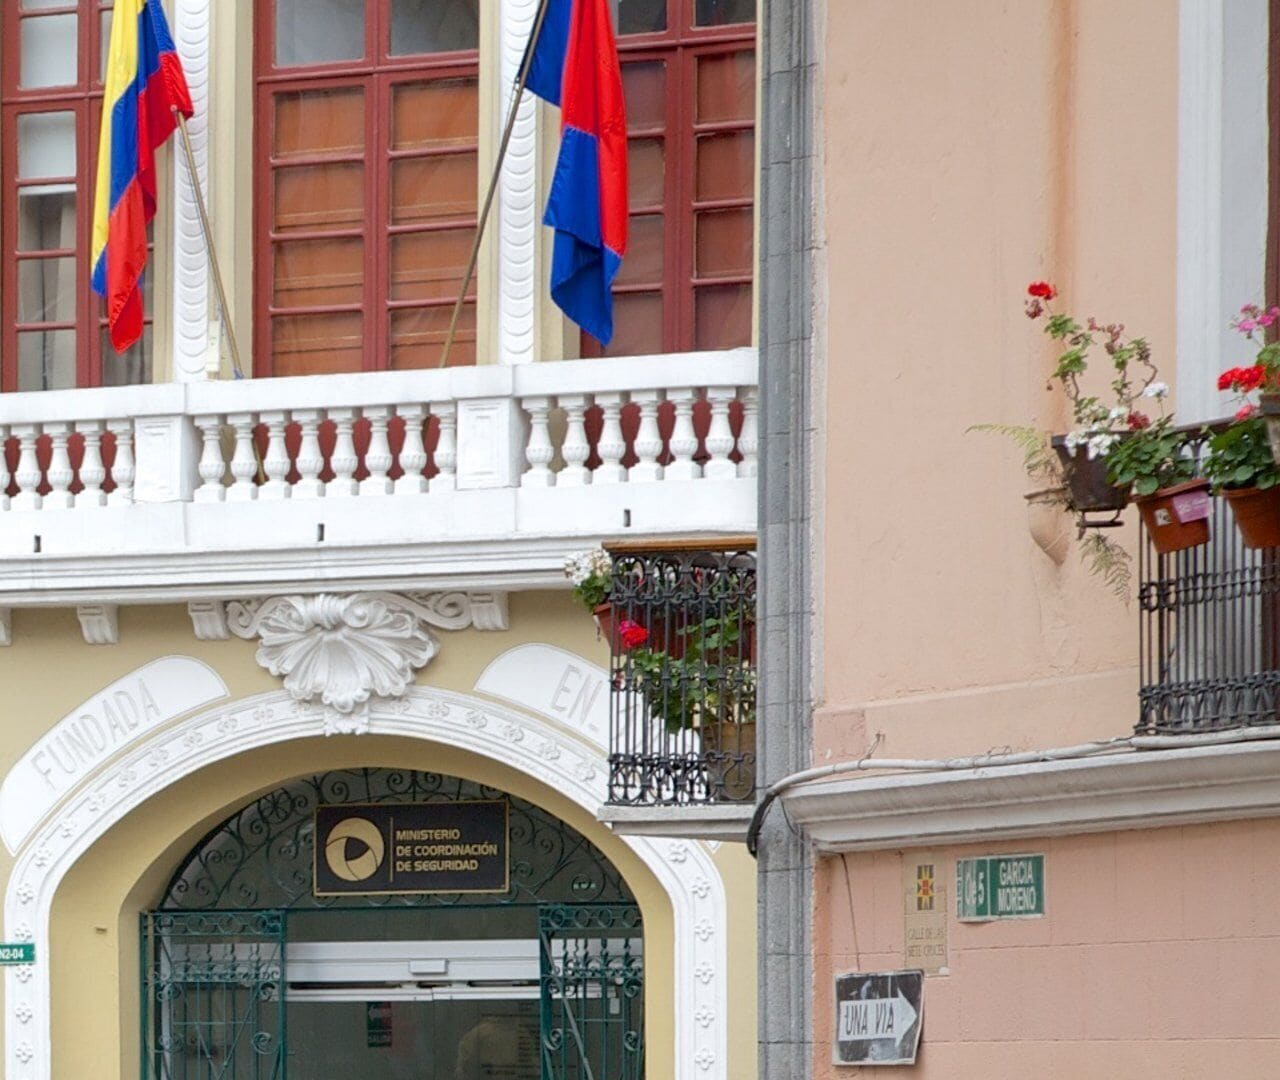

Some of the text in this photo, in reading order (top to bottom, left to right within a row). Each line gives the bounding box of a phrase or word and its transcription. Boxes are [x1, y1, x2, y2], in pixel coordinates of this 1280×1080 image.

[31, 678, 160, 790] FUNDADA
[396, 829, 460, 840] MINISTERIO
[396, 841, 497, 856] DE COORDINACIÓN
[396, 860, 479, 871] DE SEGURIDAD
[998, 886, 1037, 911] MORENO
[845, 1002, 894, 1036] UNA VIA
